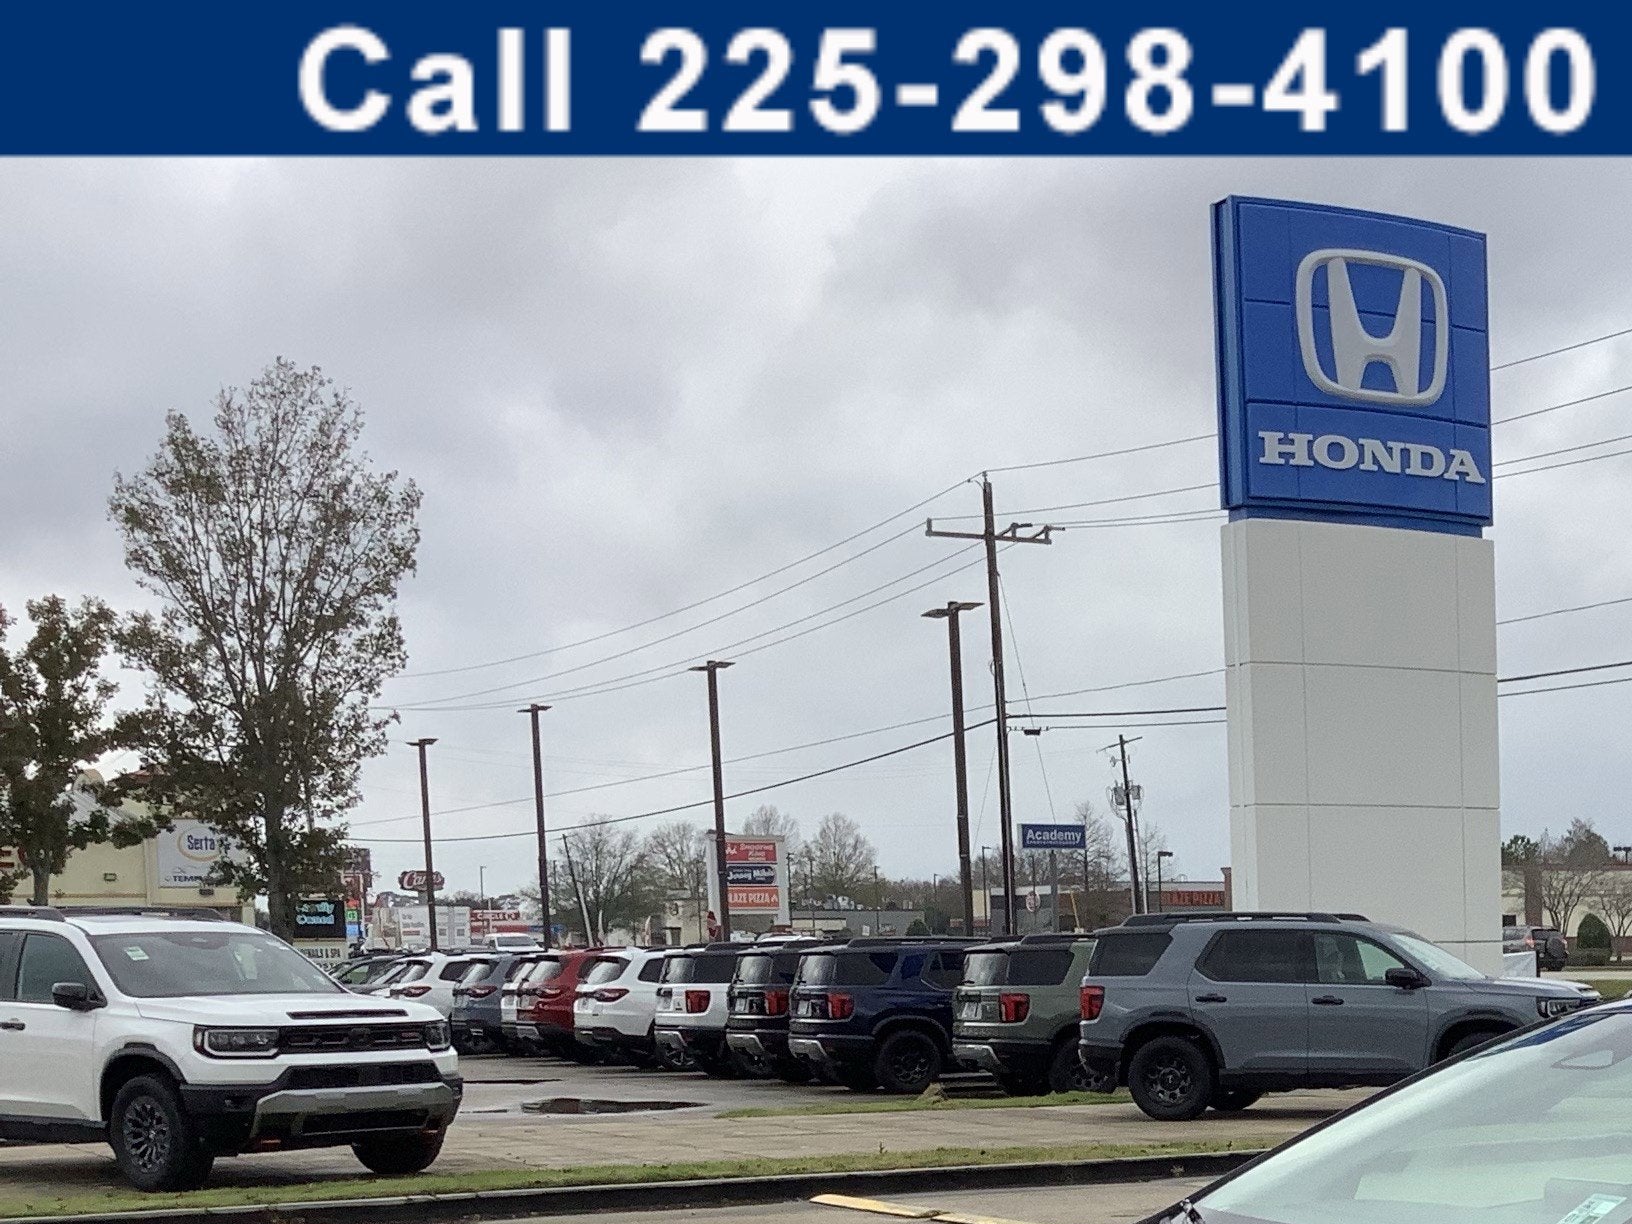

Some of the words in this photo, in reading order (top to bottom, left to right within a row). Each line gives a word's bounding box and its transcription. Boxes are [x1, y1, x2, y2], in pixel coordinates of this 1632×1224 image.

[1258, 431, 1486, 484] HONDA
[187, 834, 215, 850] Serta
[1026, 828, 1081, 844] Academy
[749, 892, 770, 904] PIZZA
